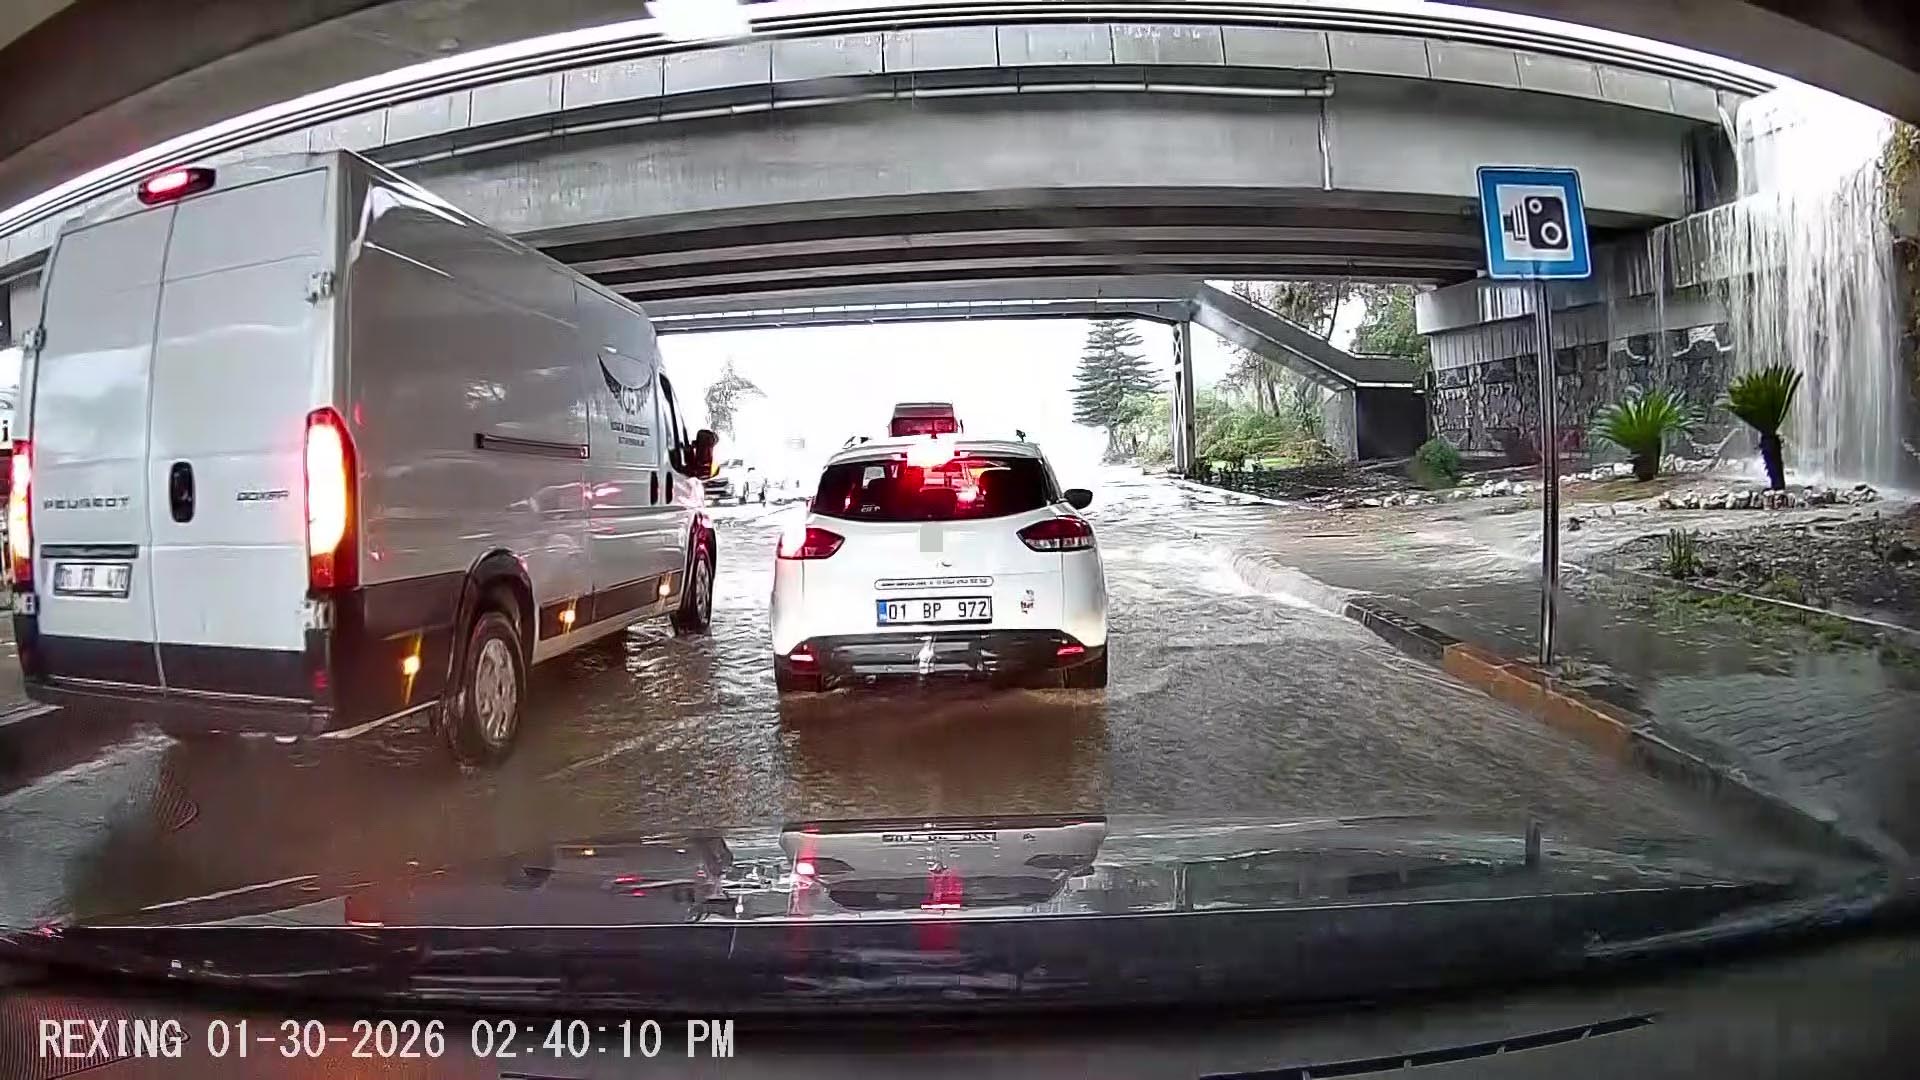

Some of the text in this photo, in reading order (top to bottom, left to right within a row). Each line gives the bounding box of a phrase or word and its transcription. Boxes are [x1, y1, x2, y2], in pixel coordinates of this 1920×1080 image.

[44, 497, 129, 509] PEUGEOT
[888, 601, 988, 620] 01 BP 972
